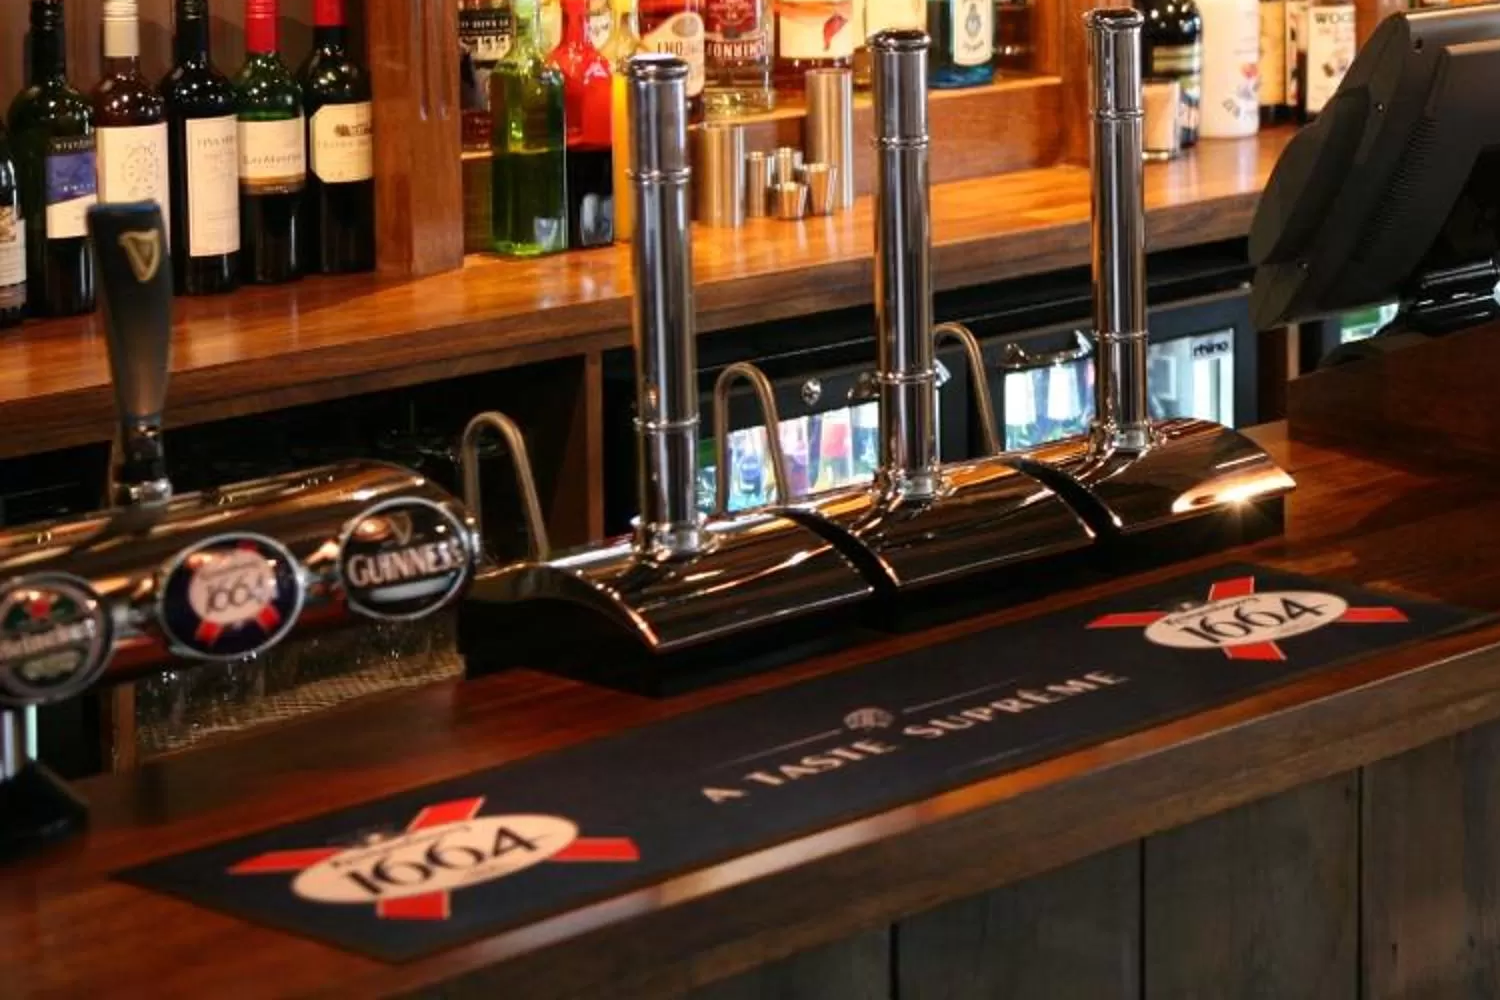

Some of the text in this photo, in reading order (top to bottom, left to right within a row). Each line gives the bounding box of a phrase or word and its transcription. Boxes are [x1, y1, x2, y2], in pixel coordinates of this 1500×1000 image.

[347, 536, 464, 588] GUINNESS
[1178, 597, 1329, 645] 1664
[702, 784, 749, 804] A
[745, 736, 898, 787] TASTE
[343, 825, 552, 896] 1664
